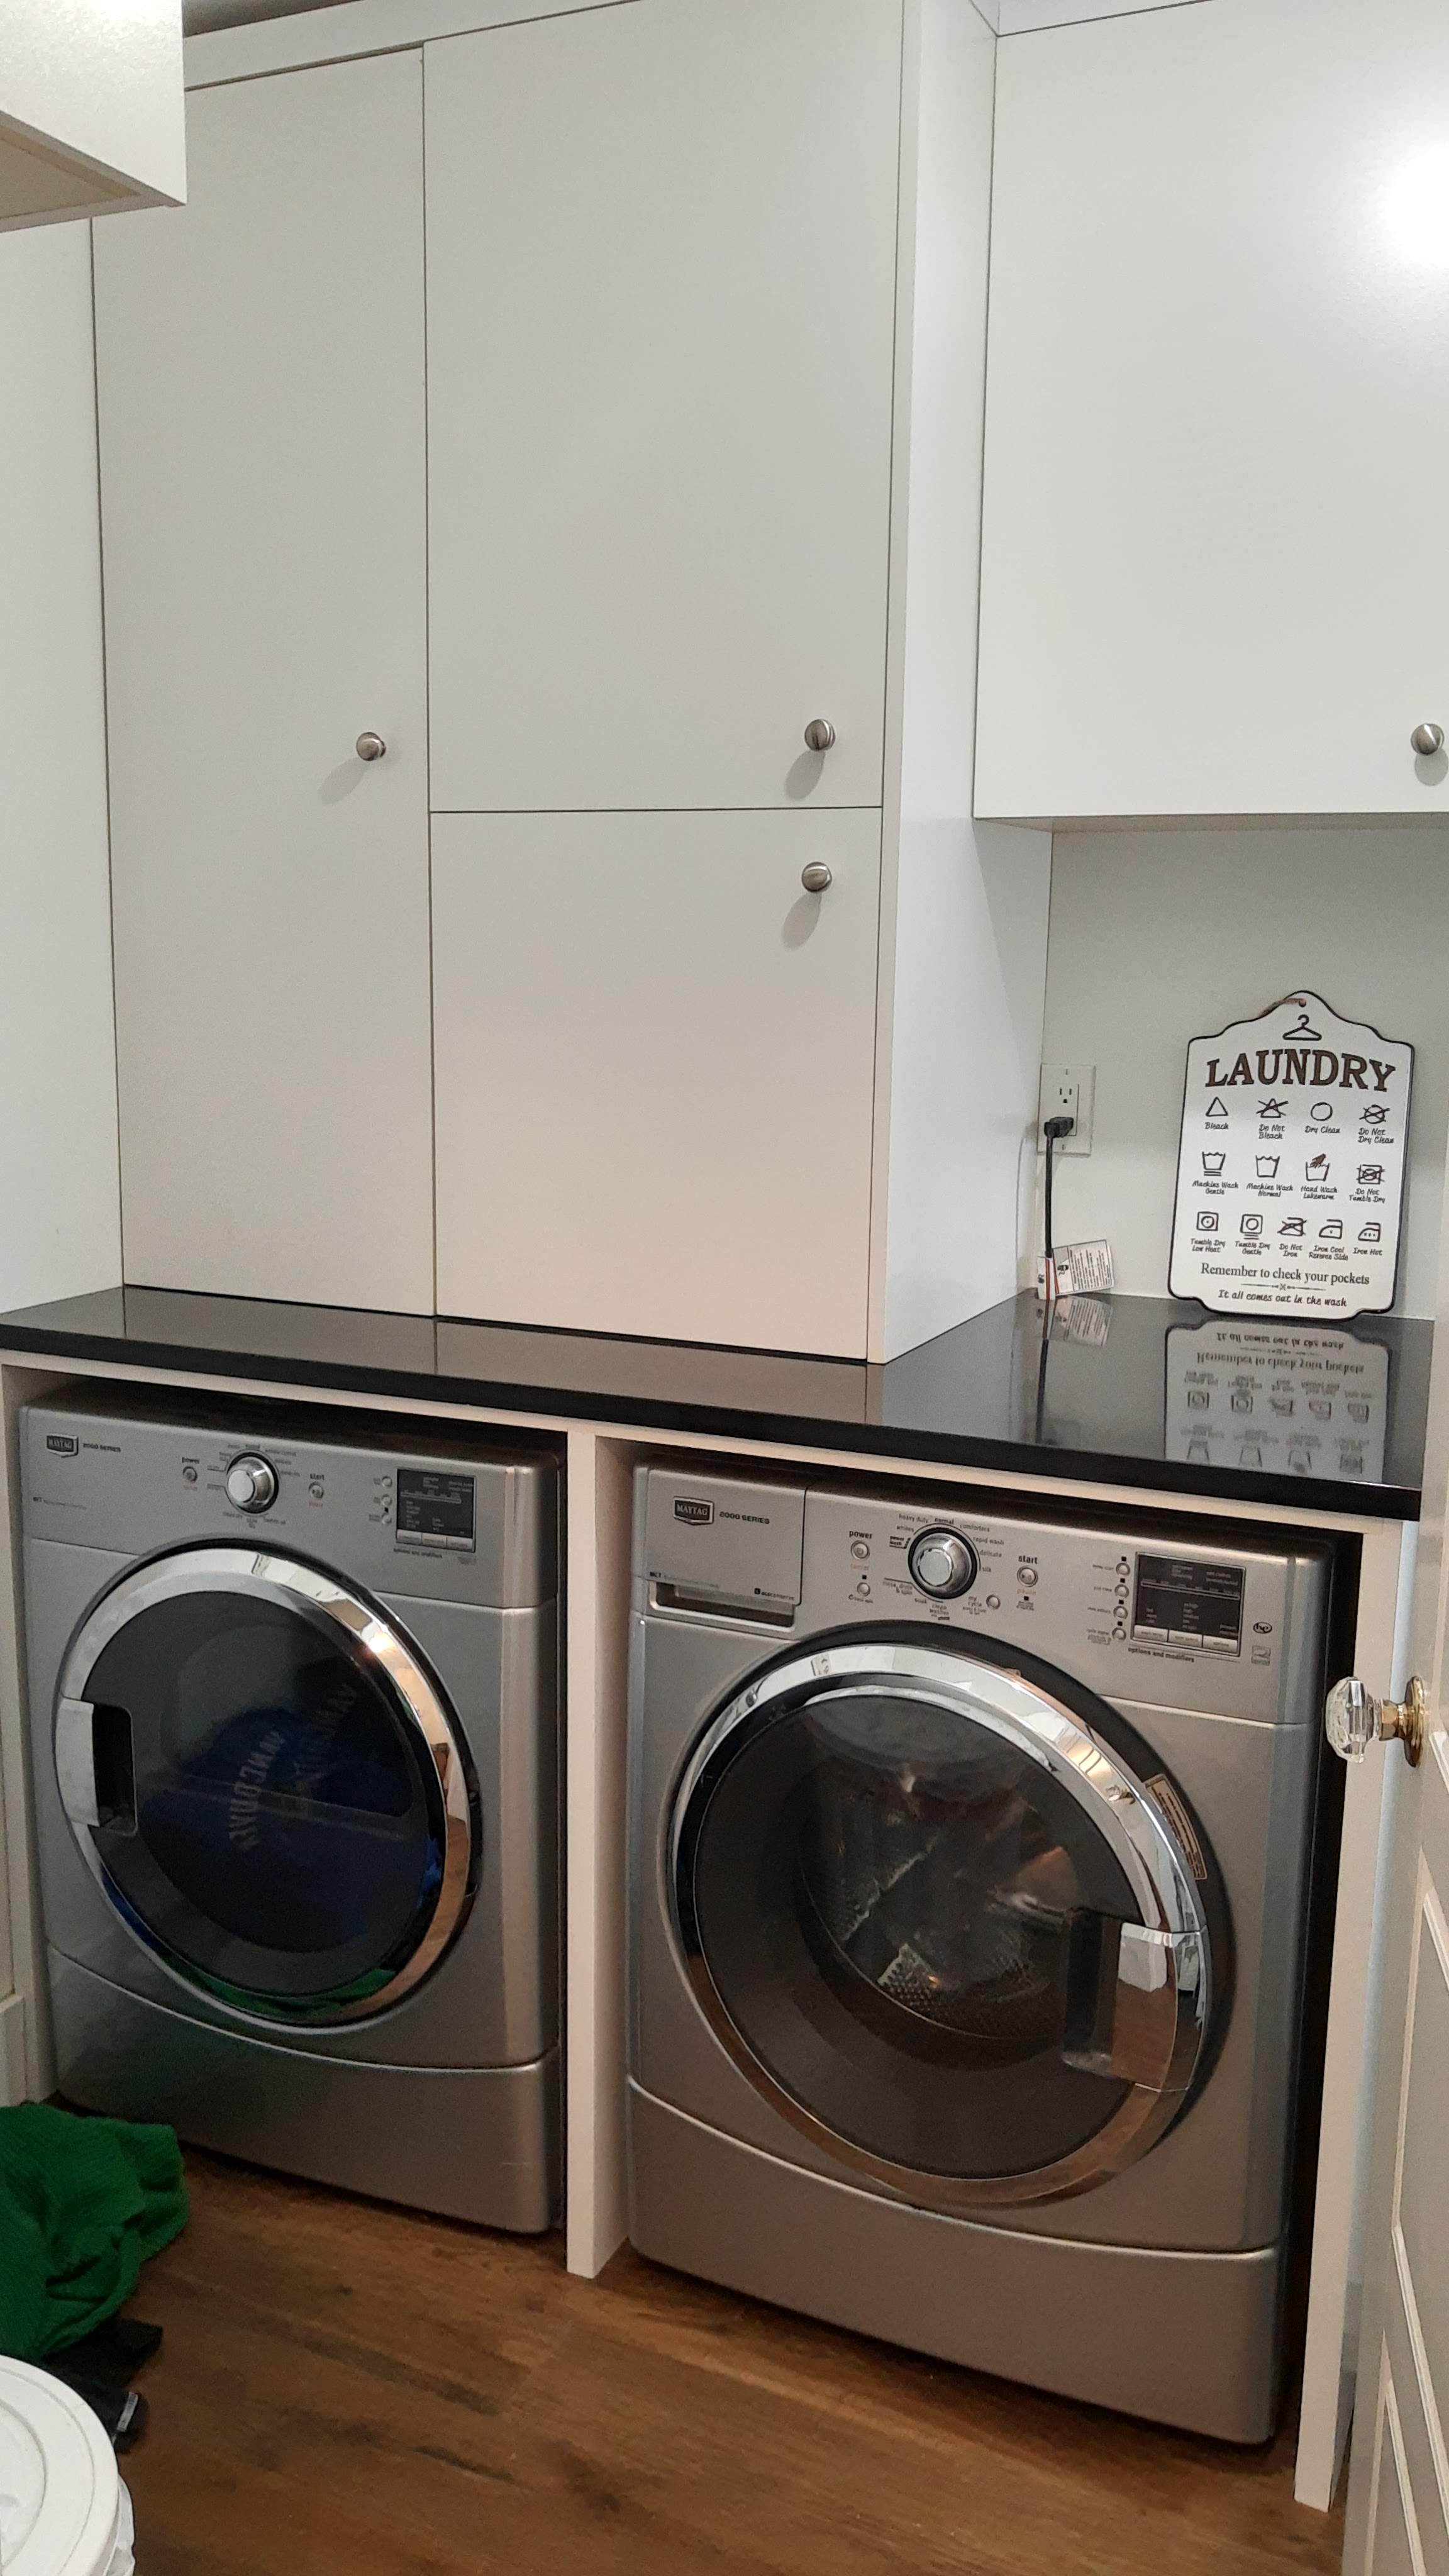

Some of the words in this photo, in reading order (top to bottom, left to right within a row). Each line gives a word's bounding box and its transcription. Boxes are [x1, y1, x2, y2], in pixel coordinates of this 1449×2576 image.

[1205, 1048, 1396, 1092] LAUNDRY
[1358, 1136, 1372, 1144] Dry
[1214, 1240, 1226, 1248] Dry
[1201, 1262, 1257, 1277] Remember
[1260, 1268, 1270, 1278] to
[1272, 1268, 1301, 1280] check
[1304, 1272, 1329, 1284] your
[1331, 1272, 1370, 1285] pockets
[1218, 1289, 1229, 1299] It
[1231, 1291, 1243, 1300] all
[1275, 1295, 1291, 1303] out
[1294, 1294, 1303, 1304] in
[1306, 1296, 1321, 1306] the
[1324, 1298, 1347, 1307] wash
[676, 1504, 708, 1516] MAYTAG
[719, 1511, 740, 1520] 2000
[741, 1514, 770, 1524] SERIES
[849, 1530, 873, 1539] power
[1018, 1555, 1038, 1565] start
[1128, 1646, 1151, 1657] options
[1165, 1653, 1194, 1663] modifiers
